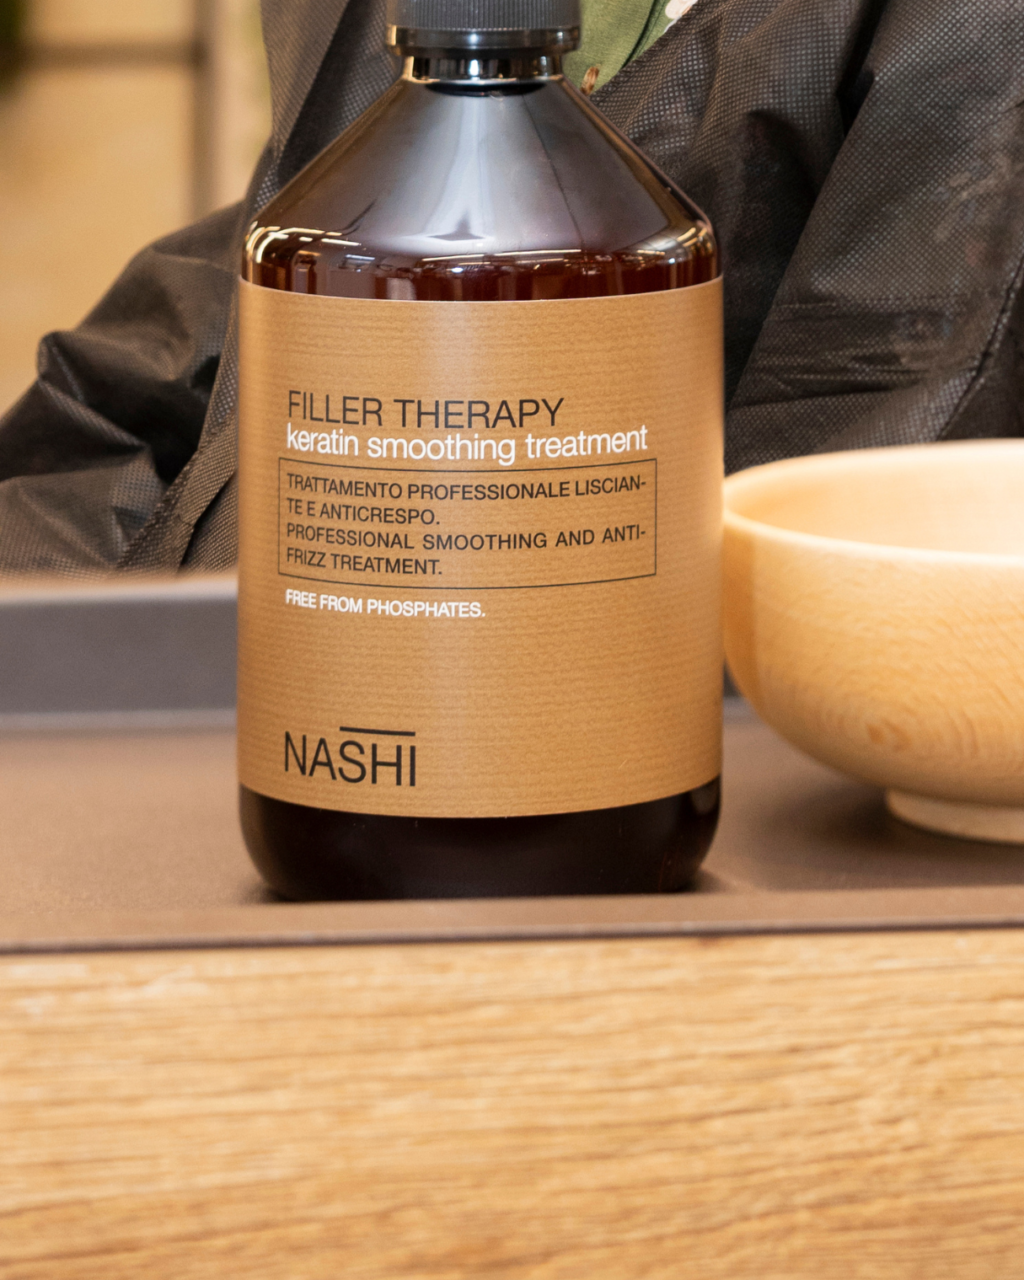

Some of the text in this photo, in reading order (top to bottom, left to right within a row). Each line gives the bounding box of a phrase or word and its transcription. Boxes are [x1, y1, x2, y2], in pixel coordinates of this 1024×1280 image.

[288, 389, 565, 429] FILLER THERAPY
[286, 422, 648, 467] keratin smoothing treatment
[286, 473, 647, 501] TRATTAMENTO PROFESSIONALE LISCIAN-
[286, 497, 441, 525] TE E ANTICRESPO.
[286, 522, 647, 551] PROFESSIONAL SMOOTHING AND ANTI-
[286, 546, 443, 575] FRIZZ TREATMENT.
[285, 588, 487, 618] FREE FROM PHOSPHATES.
[284, 729, 417, 787] NASHI
